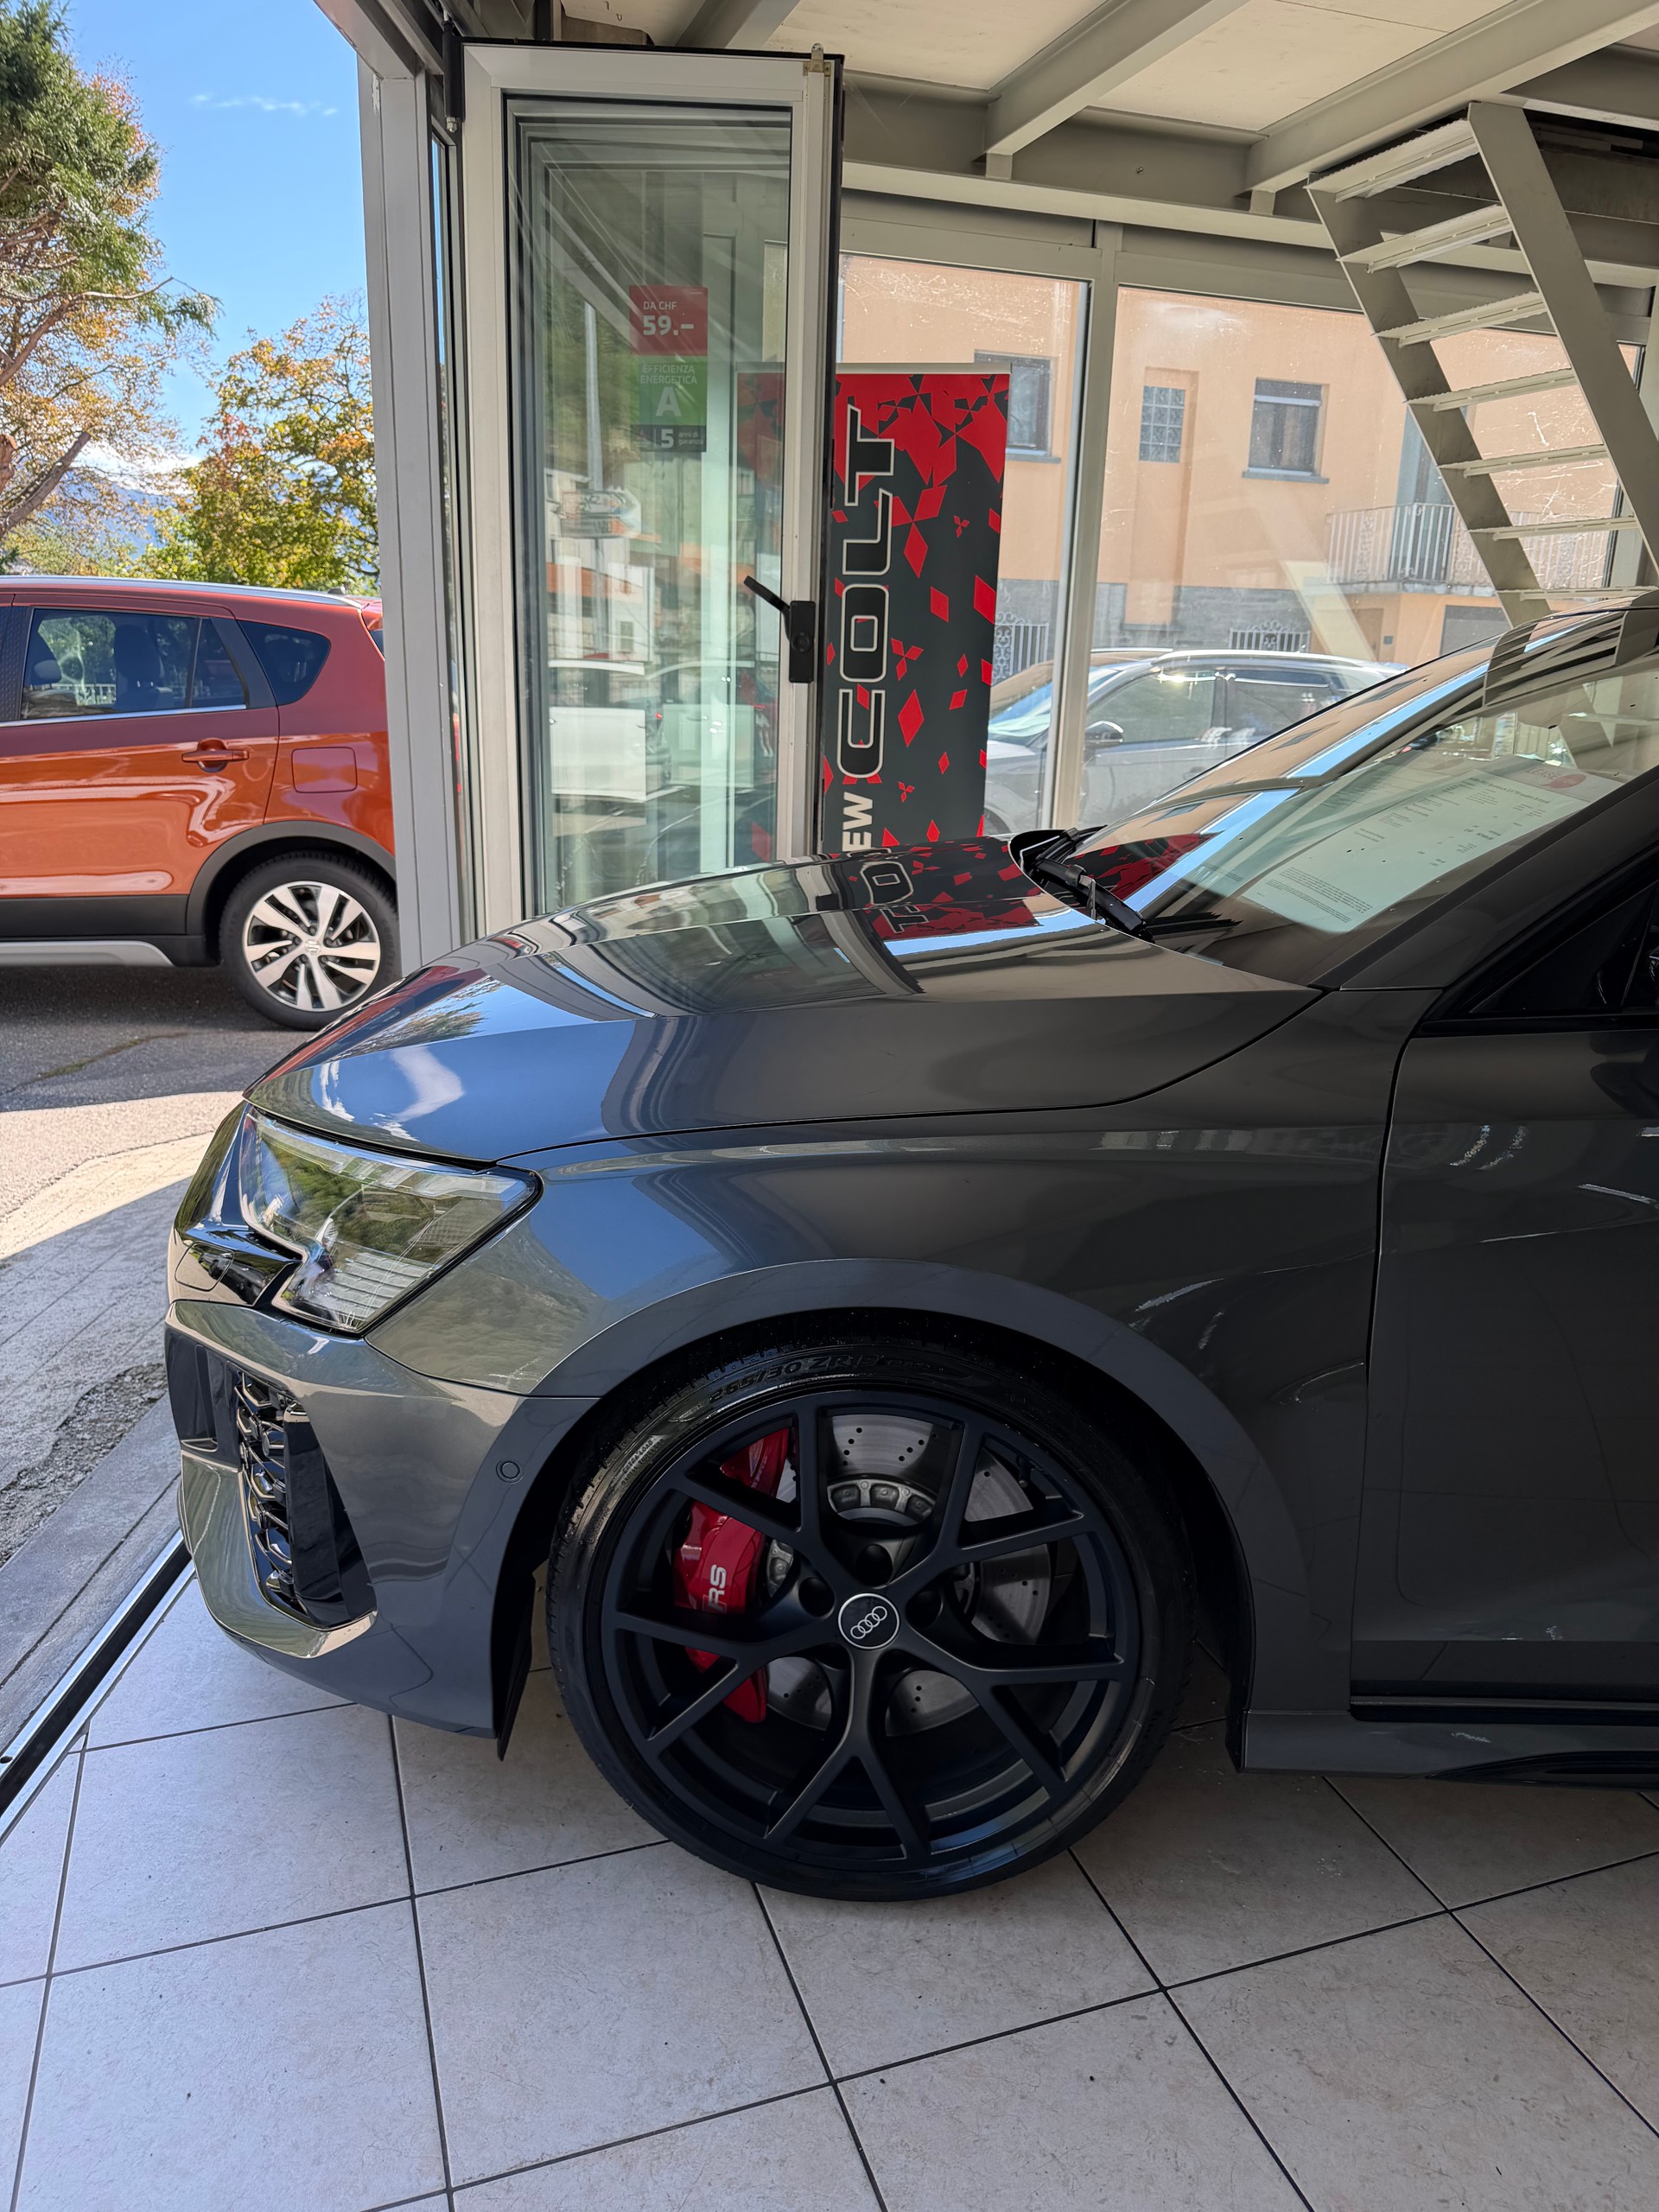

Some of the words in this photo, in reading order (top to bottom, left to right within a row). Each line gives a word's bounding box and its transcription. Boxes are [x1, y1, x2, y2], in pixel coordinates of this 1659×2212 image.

[643, 302, 657, 310] DA
[658, 302, 677, 310] CHF
[639, 375, 697, 385] ENERGETICA
[642, 365, 696, 374] EFFICIENZA
[655, 386, 682, 416] A
[660, 429, 675, 448] 5
[836, 403, 895, 779] COLT
[842, 792, 874, 853] EW
[709, 1564, 727, 1612] RS
